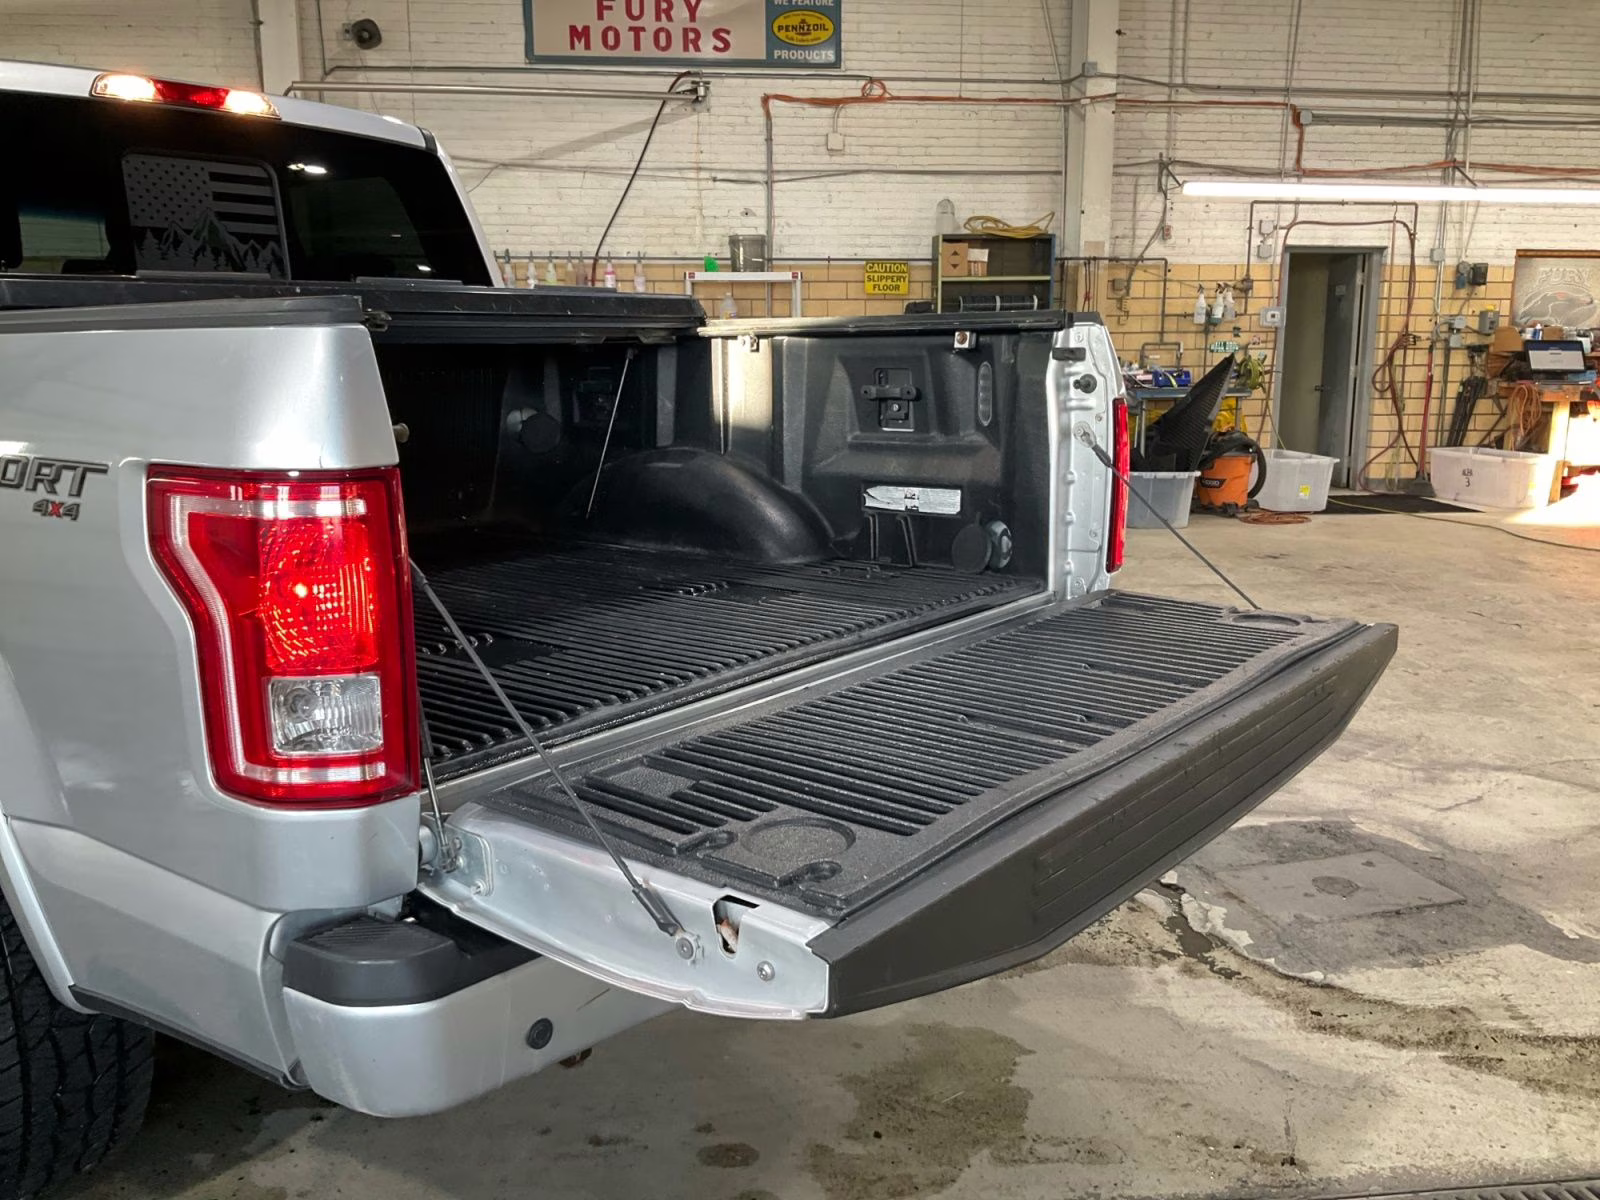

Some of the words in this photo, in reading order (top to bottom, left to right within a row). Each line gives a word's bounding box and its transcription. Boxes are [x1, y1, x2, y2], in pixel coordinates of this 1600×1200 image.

[597, 0, 703, 22] FURY
[777, 23, 829, 33] PENNZOIL
[568, 24, 732, 53] MOTORS
[773, 49, 835, 60] PRODUCTS
[866, 263, 907, 273] CAUTION
[866, 274, 907, 282] SLIPPERY
[872, 283, 901, 291] FLOOR
[0, 455, 110, 498] ORT
